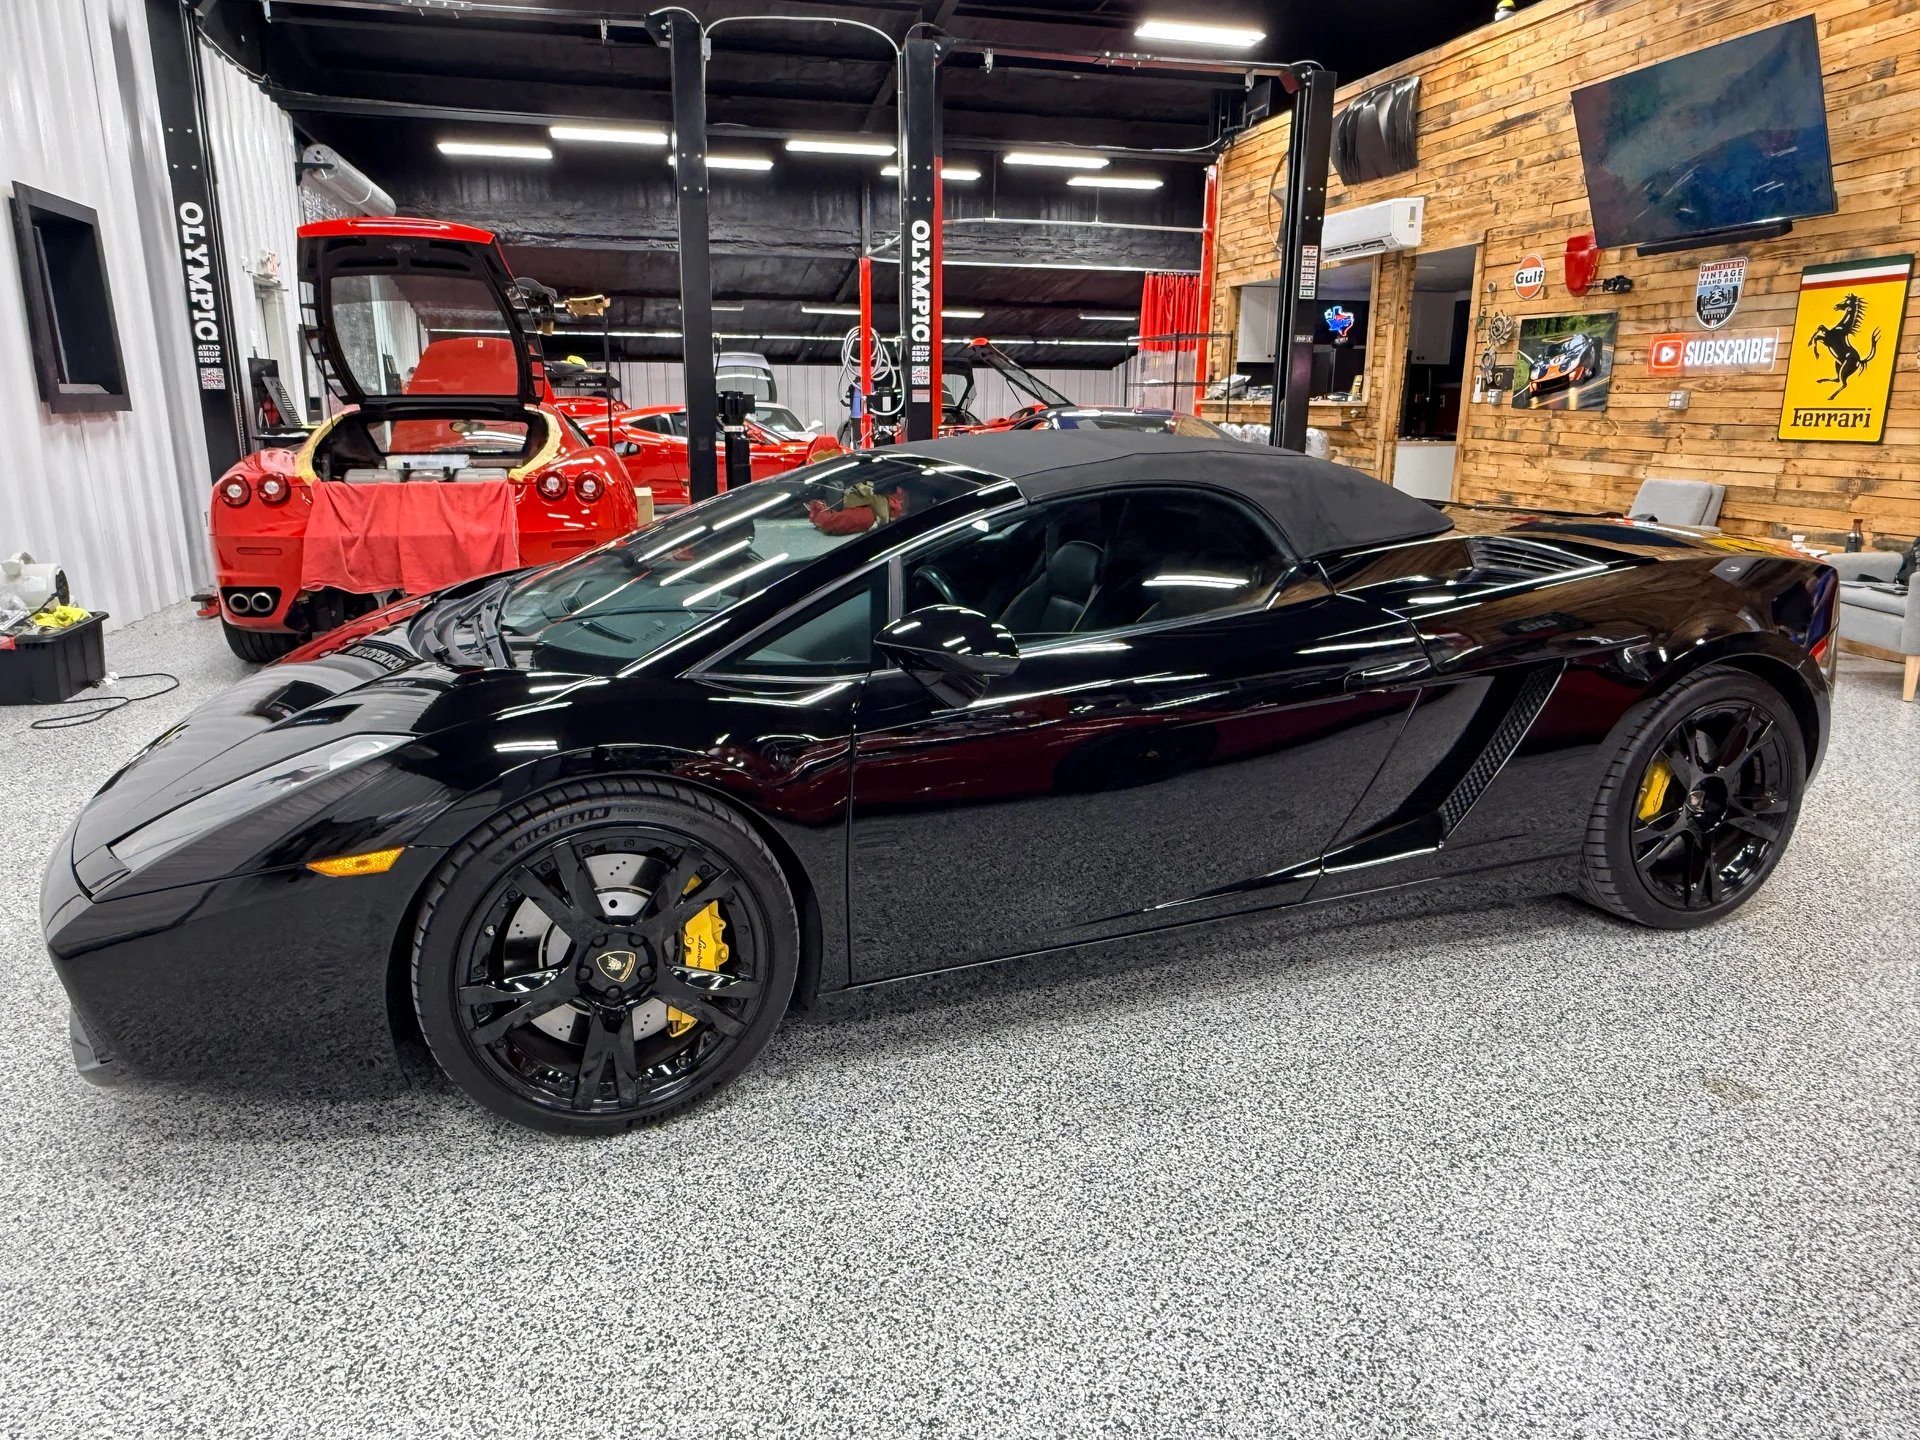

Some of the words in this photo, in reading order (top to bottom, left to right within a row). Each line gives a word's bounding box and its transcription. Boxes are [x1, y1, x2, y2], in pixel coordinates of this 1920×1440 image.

[179, 201, 219, 341] OLYMPIC
[911, 220, 930, 342] OLYMPIC
[1515, 270, 1543, 284] Gulf
[1700, 268, 1743, 280] VINTAGE
[1684, 337, 1774, 366] SUBSCRIBE
[1790, 408, 1872, 428] Ferrari
[514, 808, 606, 849] MICHELIN
